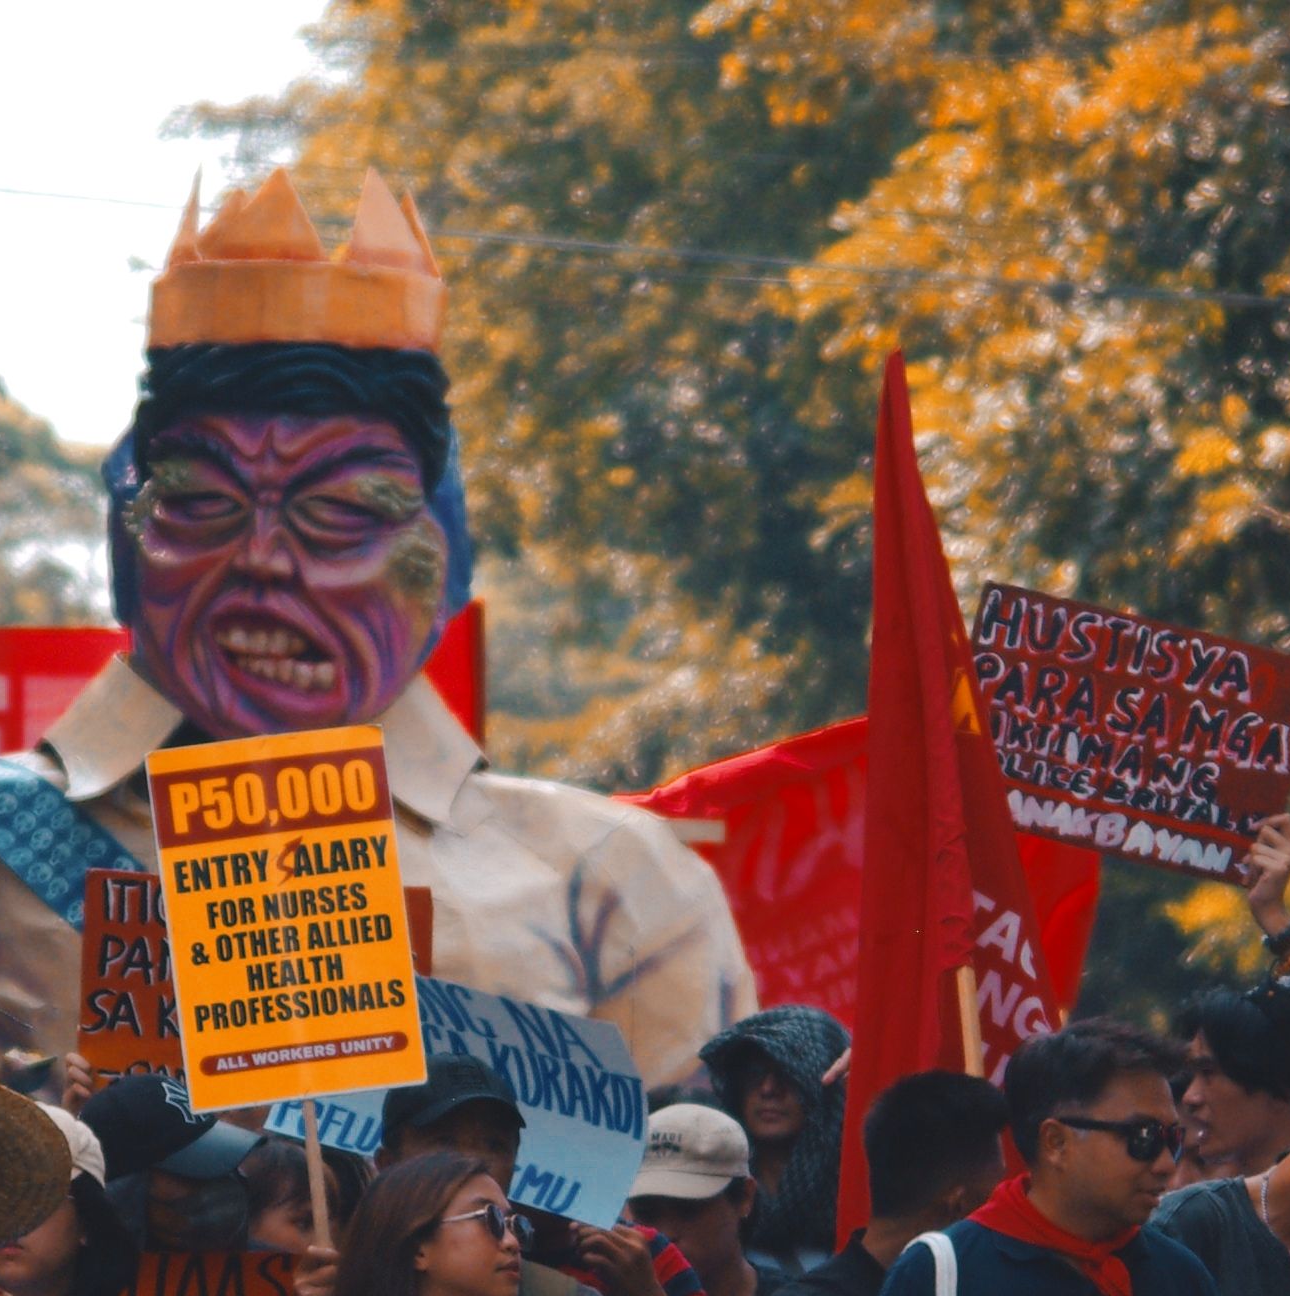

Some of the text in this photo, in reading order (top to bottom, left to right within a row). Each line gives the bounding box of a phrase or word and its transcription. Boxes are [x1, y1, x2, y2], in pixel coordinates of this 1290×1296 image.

[978, 589, 1252, 703] HUSTISYA
[973, 652, 1290, 775] PARA SA MGA
[168, 759, 377, 834] P50,000
[173, 835, 388, 893] ENTRY SALARY
[206, 882, 367, 929] FOR NURSES
[191, 914, 392, 966] & OTHER ALLIED
[246, 954, 344, 991] HEALTH
[81, 989, 143, 1038] SA
[194, 979, 405, 1032] PROFESSIONALS
[216, 1036, 395, 1071] ALL WORKERS UNITY
[500, 996, 604, 1069] NA
